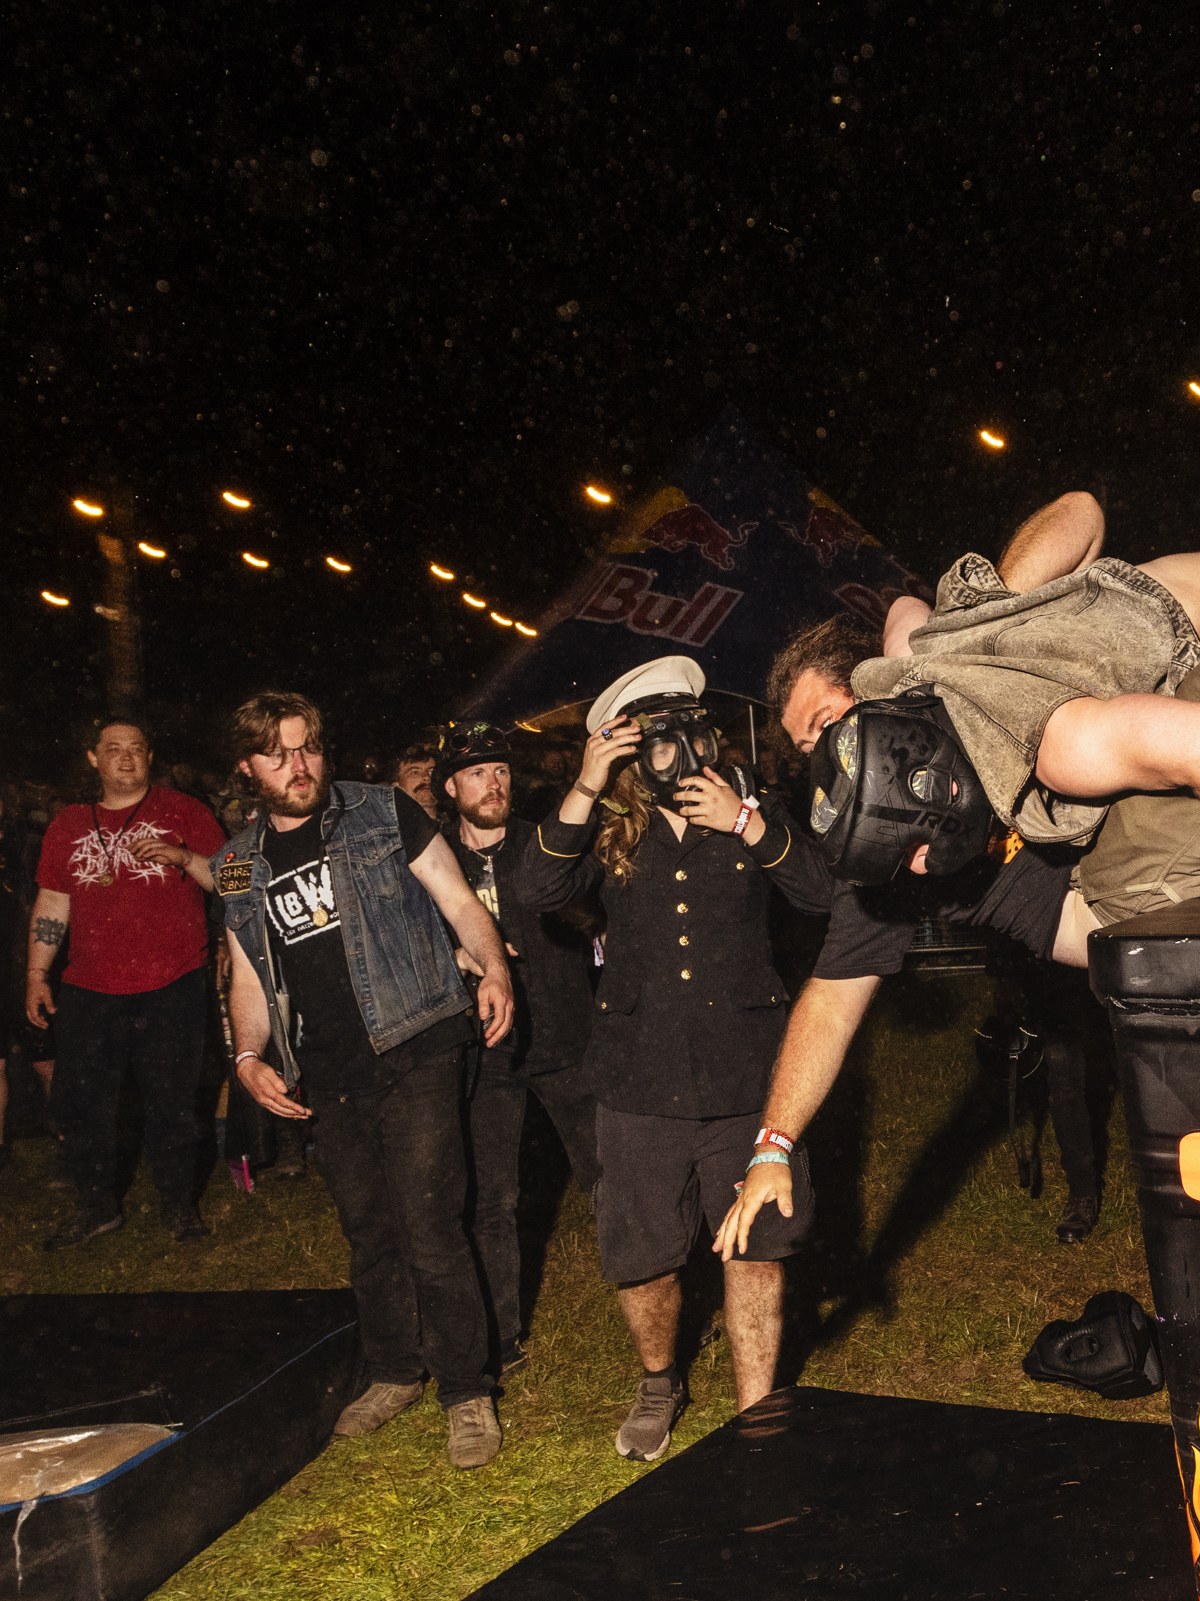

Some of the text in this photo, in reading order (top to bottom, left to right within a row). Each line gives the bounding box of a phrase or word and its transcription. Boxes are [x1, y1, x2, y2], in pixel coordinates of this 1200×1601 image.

[576, 562, 744, 648] Bull
[917, 810, 976, 837] RDX
[275, 863, 335, 928] LBW
